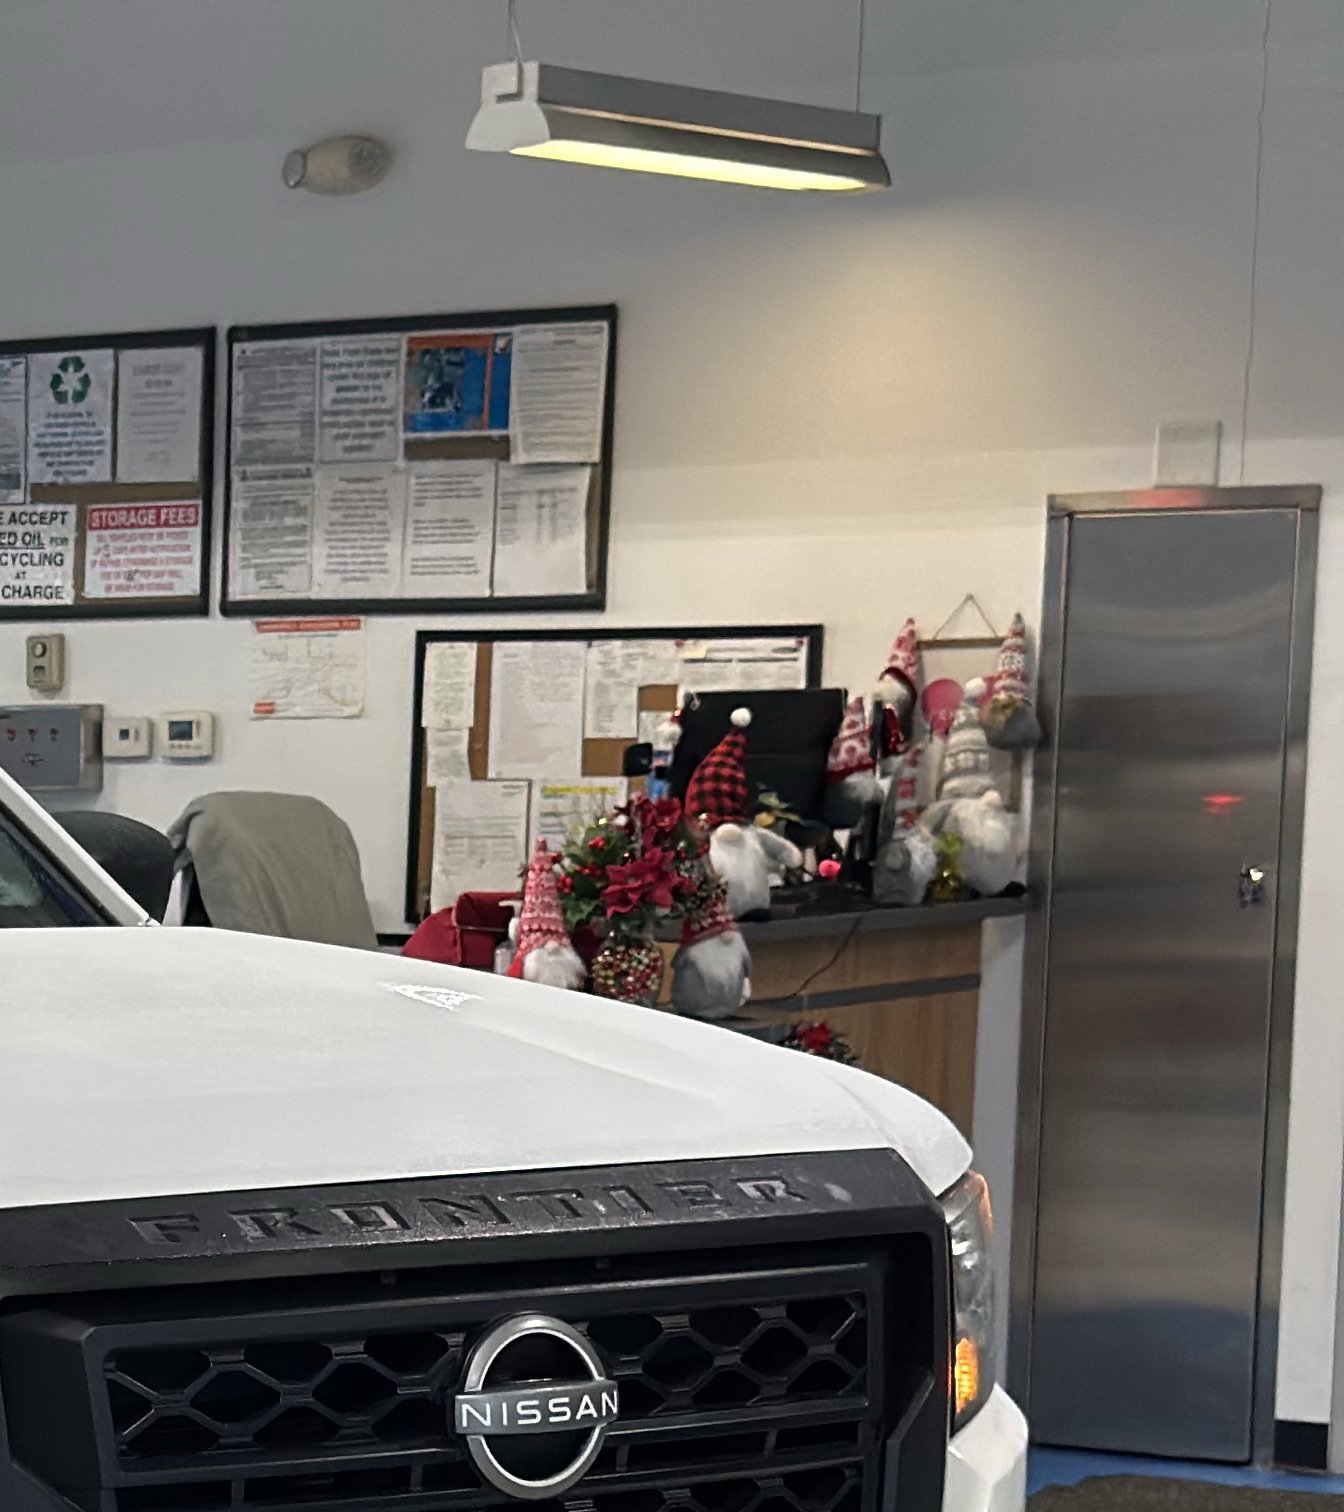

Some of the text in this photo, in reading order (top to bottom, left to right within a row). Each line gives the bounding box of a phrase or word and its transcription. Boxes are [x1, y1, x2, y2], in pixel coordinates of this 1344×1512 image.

[8, 510, 69, 526] ACCEPT
[91, 506, 196, 528] STORAGE FEES
[21, 531, 45, 547] OIL
[49, 536, 70, 547] FOR
[14, 570, 28, 580] AT
[1, 584, 65, 600] CHARGE
[126, 1174, 812, 1245] FRONTIER
[461, 1390, 619, 1428] NISSAN
